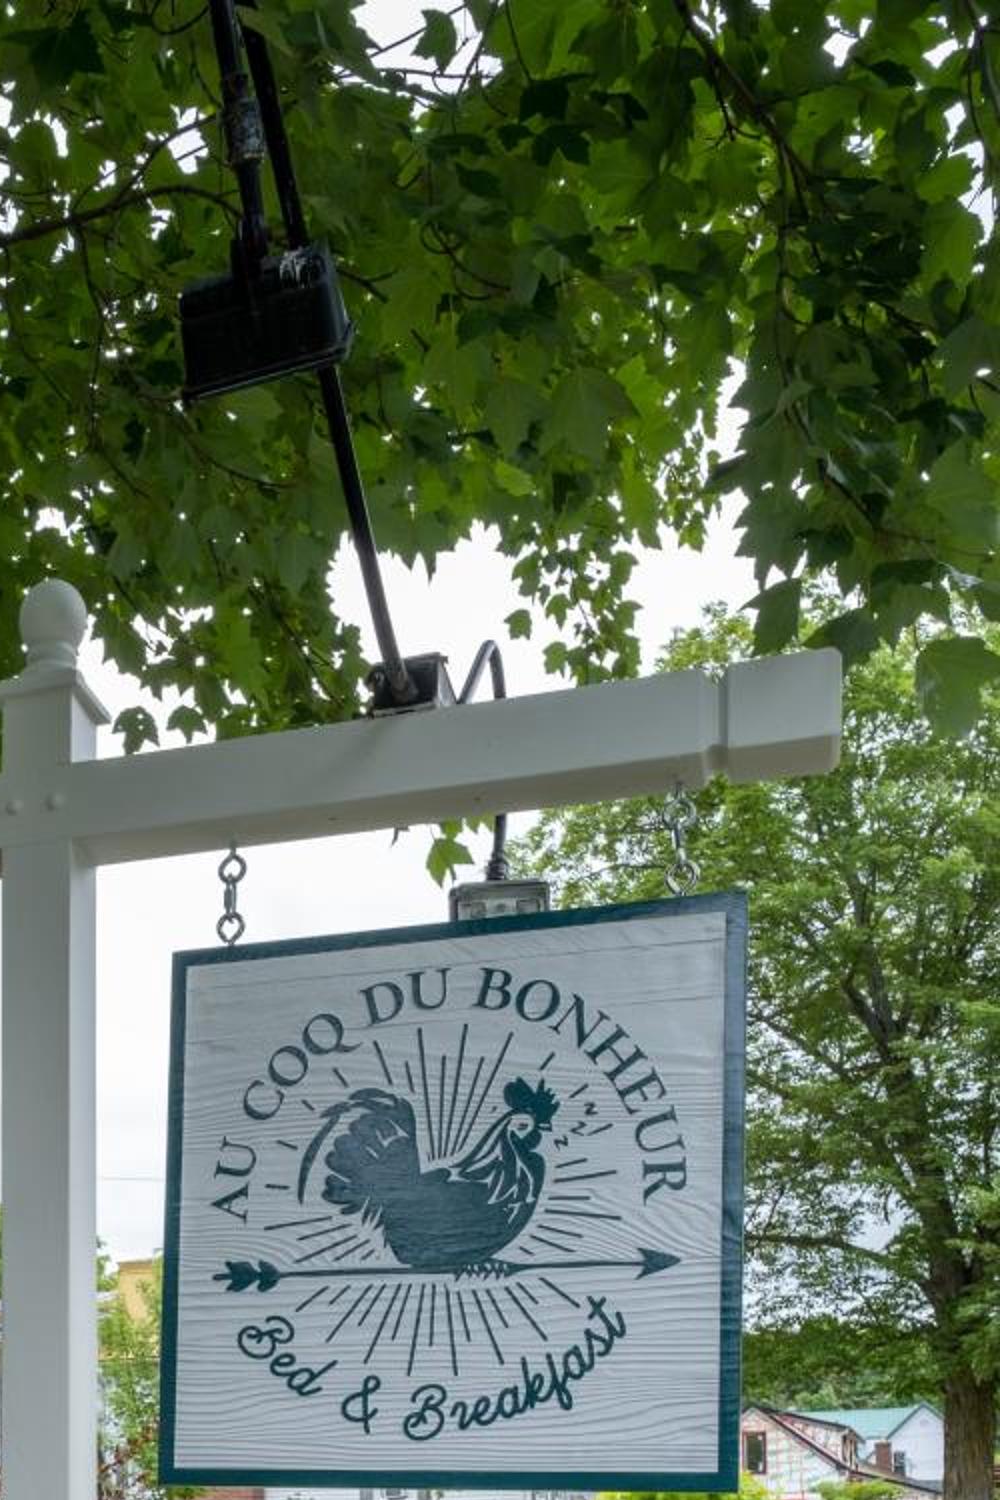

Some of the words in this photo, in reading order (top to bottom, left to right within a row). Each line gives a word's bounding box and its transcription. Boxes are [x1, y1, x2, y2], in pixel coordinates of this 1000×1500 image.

[209, 1136, 257, 1223] AU
[243, 1013, 362, 1121] COQ
[360, 967, 451, 1027] DU
[472, 966, 688, 1204] BONHEUR
[237, 1315, 338, 1397] Bed
[341, 1375, 381, 1434] &
[404, 1295, 627, 1441] Breakfast
